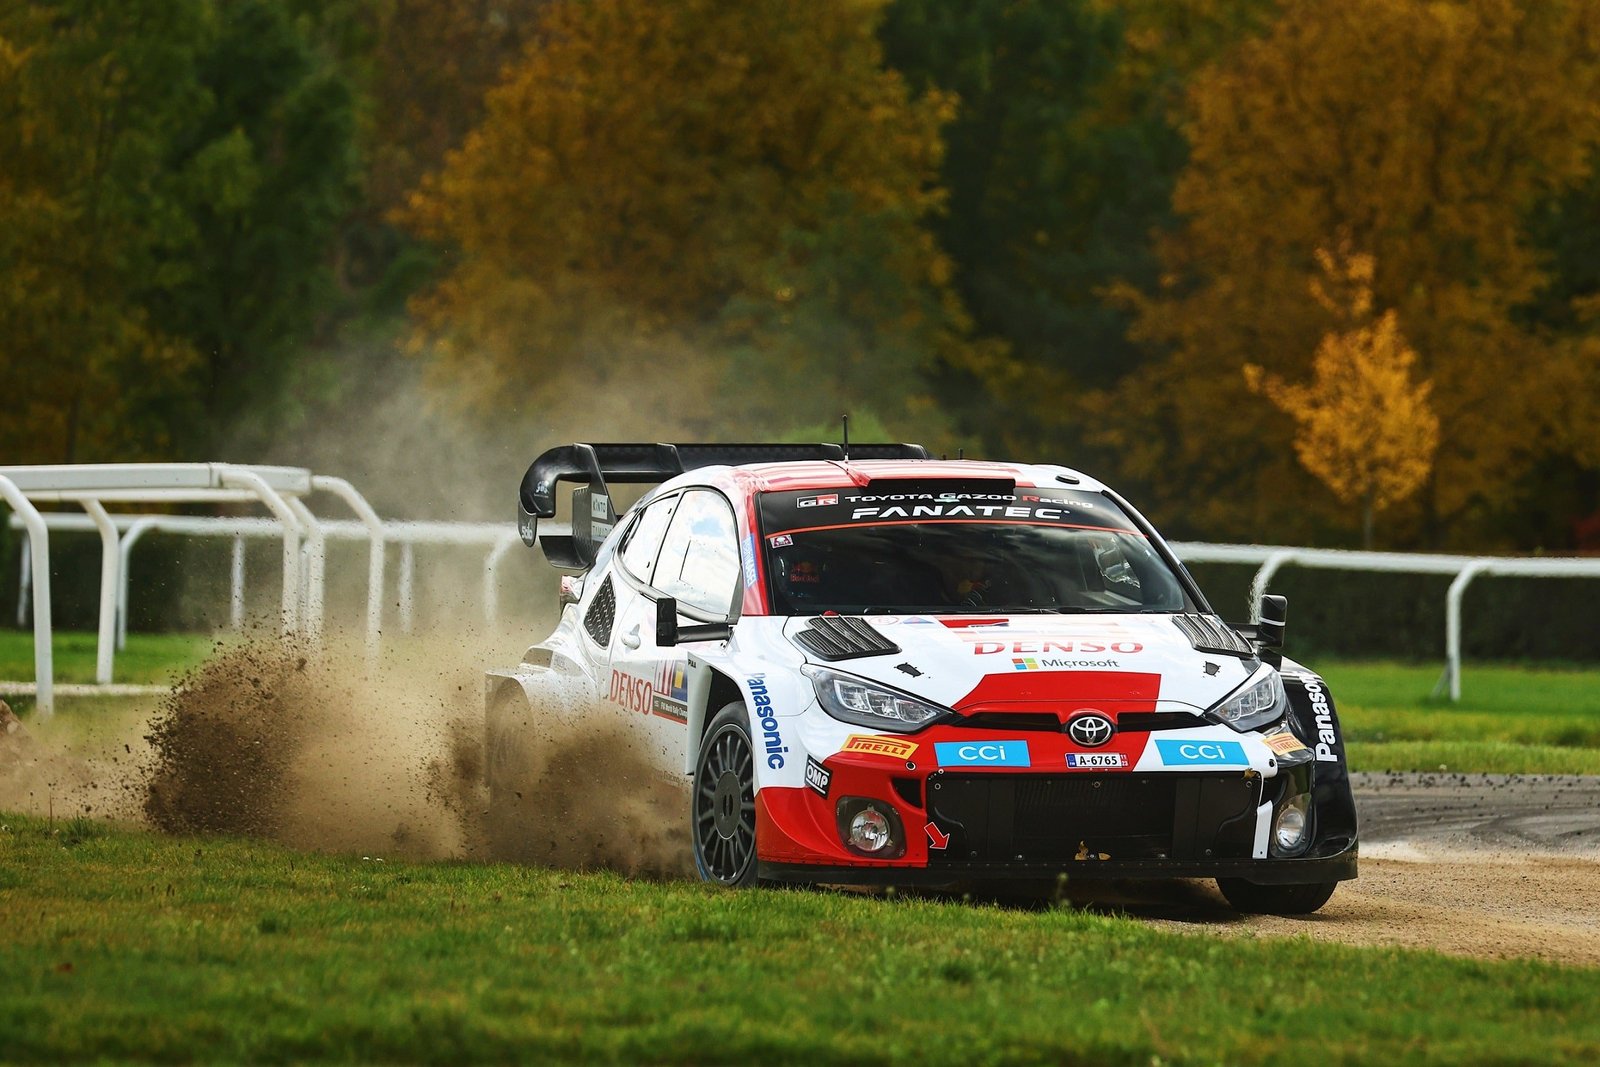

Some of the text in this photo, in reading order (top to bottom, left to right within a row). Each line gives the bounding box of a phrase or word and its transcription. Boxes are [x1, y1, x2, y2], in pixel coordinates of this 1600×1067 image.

[799, 494, 837, 507] GR
[845, 493, 932, 503] TOYOTA
[1021, 495, 1094, 509] Racing
[851, 504, 1062, 520] FANATEC
[974, 642, 1144, 655] DENSO
[1041, 658, 1121, 668] Microsoft
[609, 669, 653, 715] DENSO
[848, 737, 912, 756] PIRELLI
[1079, 755, 1118, 766] A-6765
[806, 763, 829, 789] OMP
